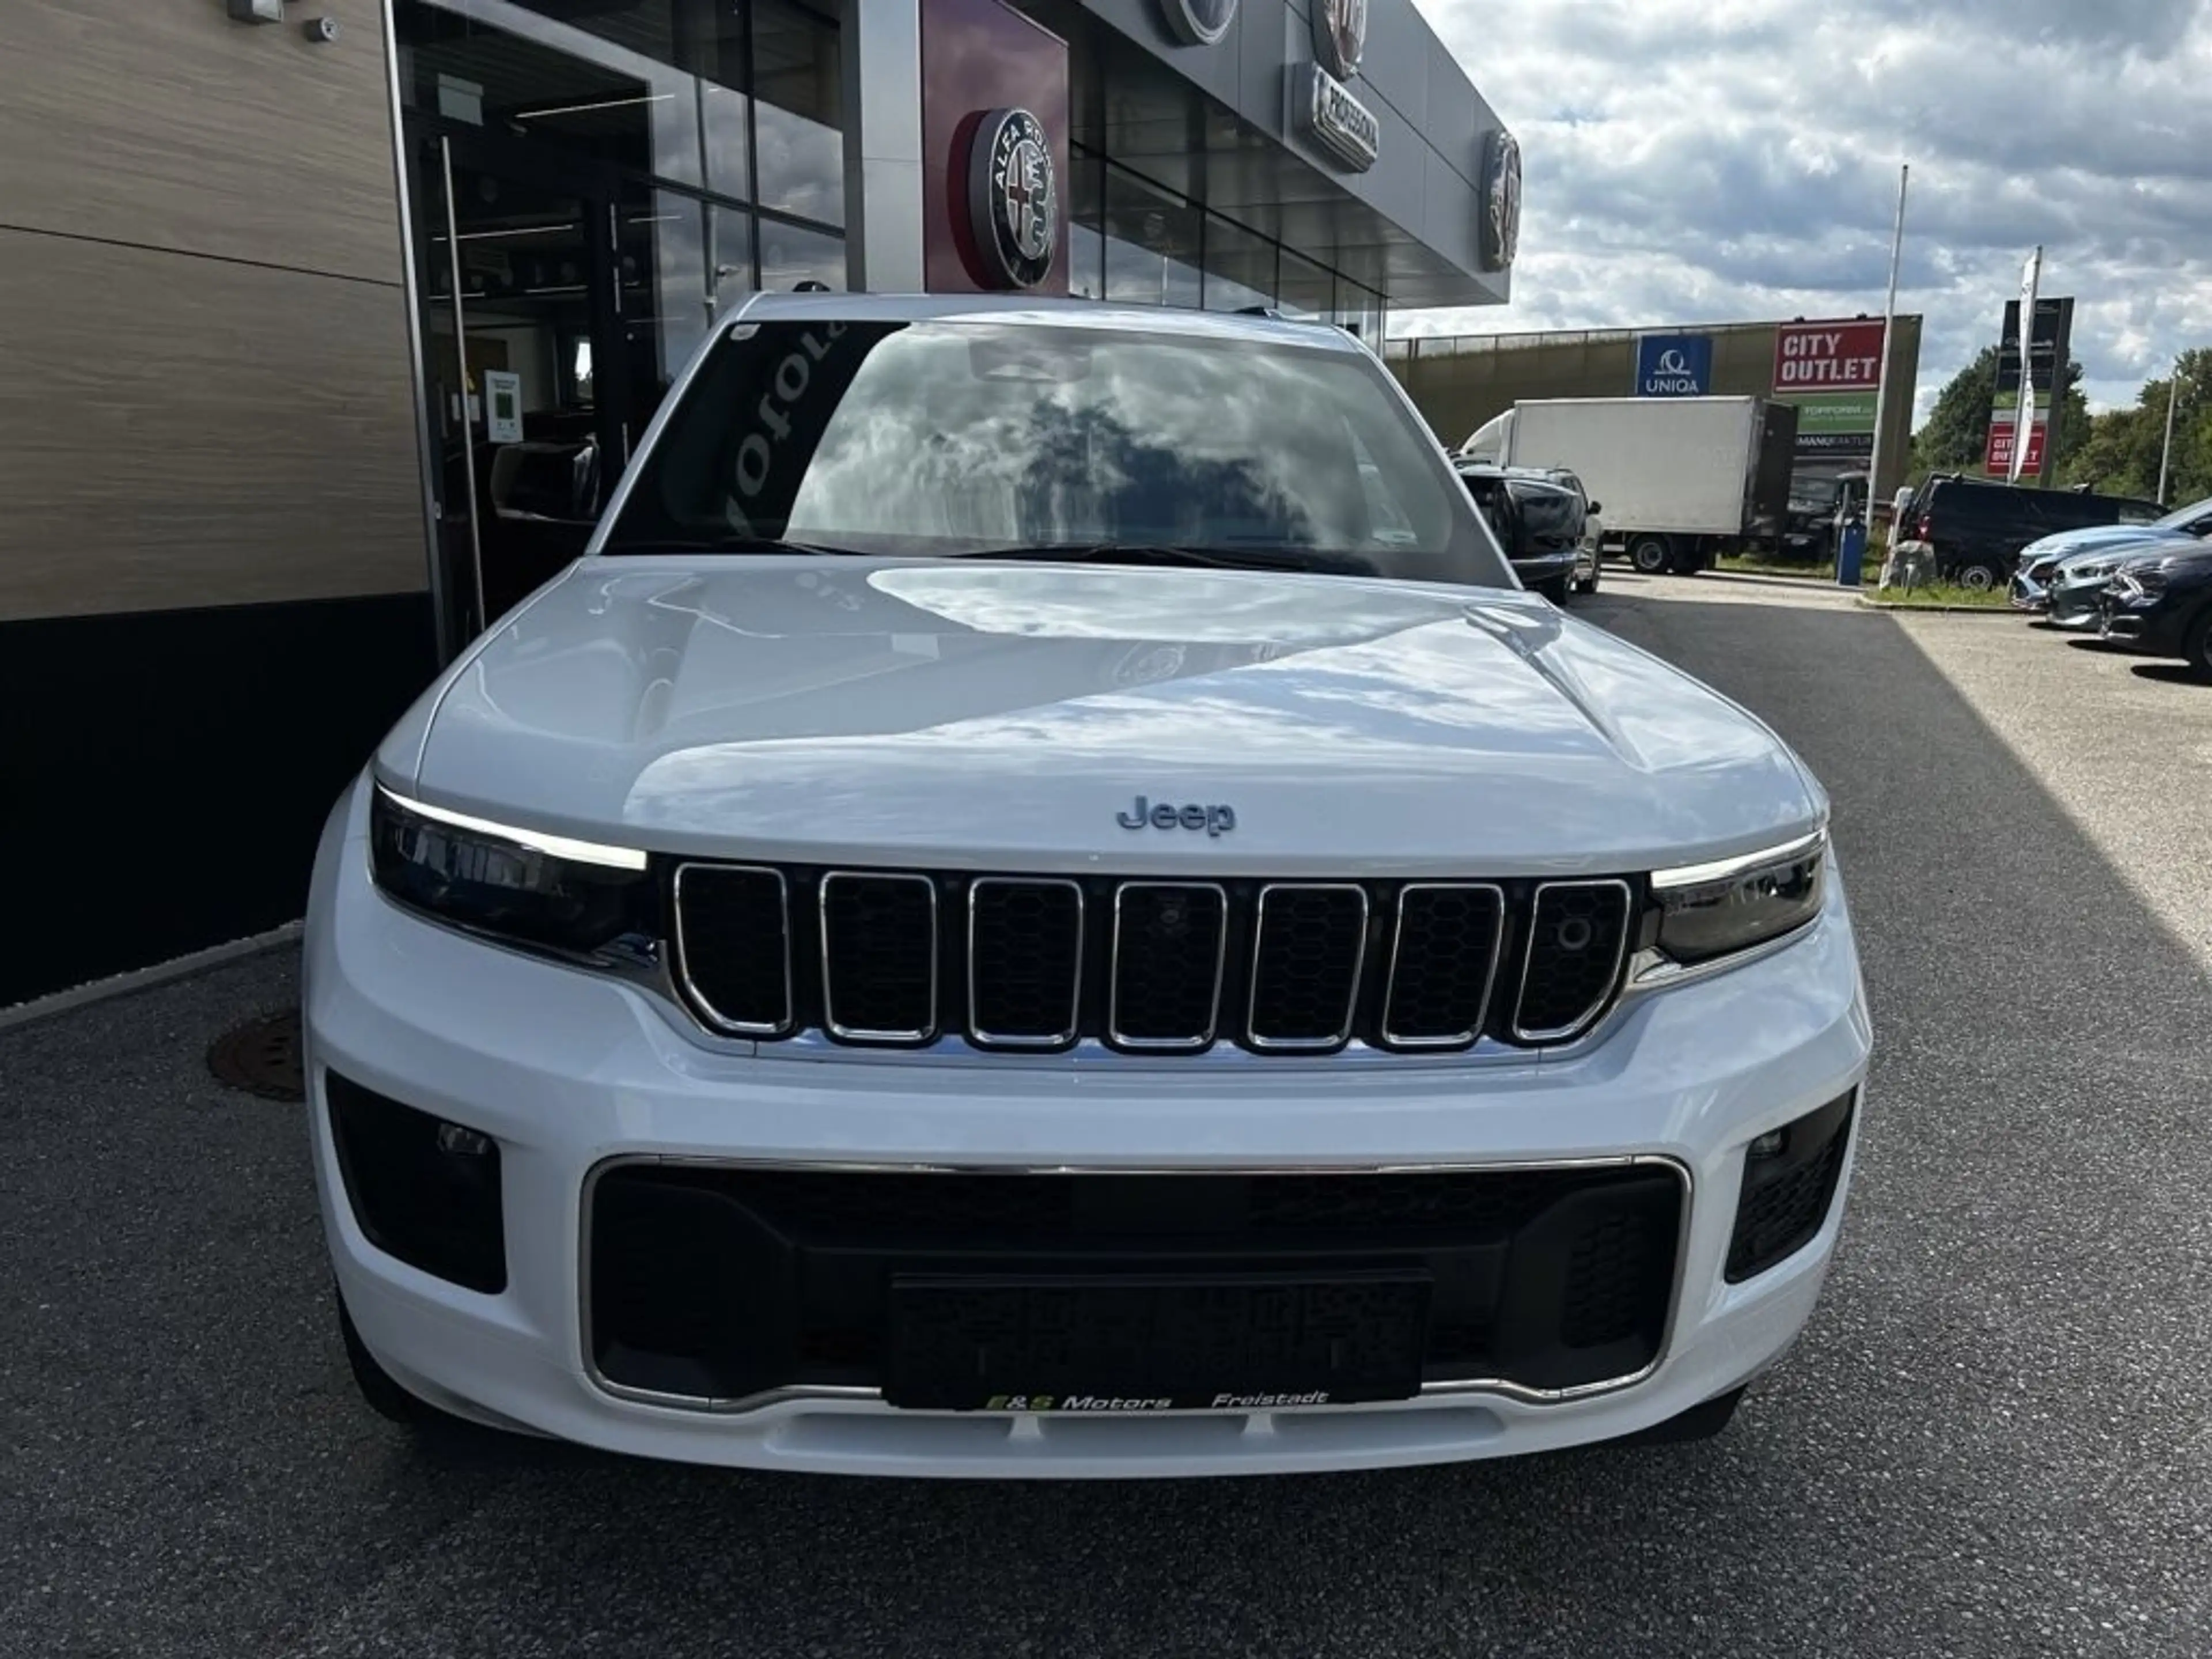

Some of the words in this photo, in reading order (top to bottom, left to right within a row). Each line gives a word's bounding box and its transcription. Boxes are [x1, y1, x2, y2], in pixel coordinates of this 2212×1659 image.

[995, 123, 1021, 189] ALFA
[1783, 332, 1842, 356] CITY
[1781, 358, 1877, 381] OUTLET
[1646, 378, 1699, 393] UNIQA
[1116, 794, 1236, 837] Jeep
[1061, 1395, 1172, 1410] Motors
